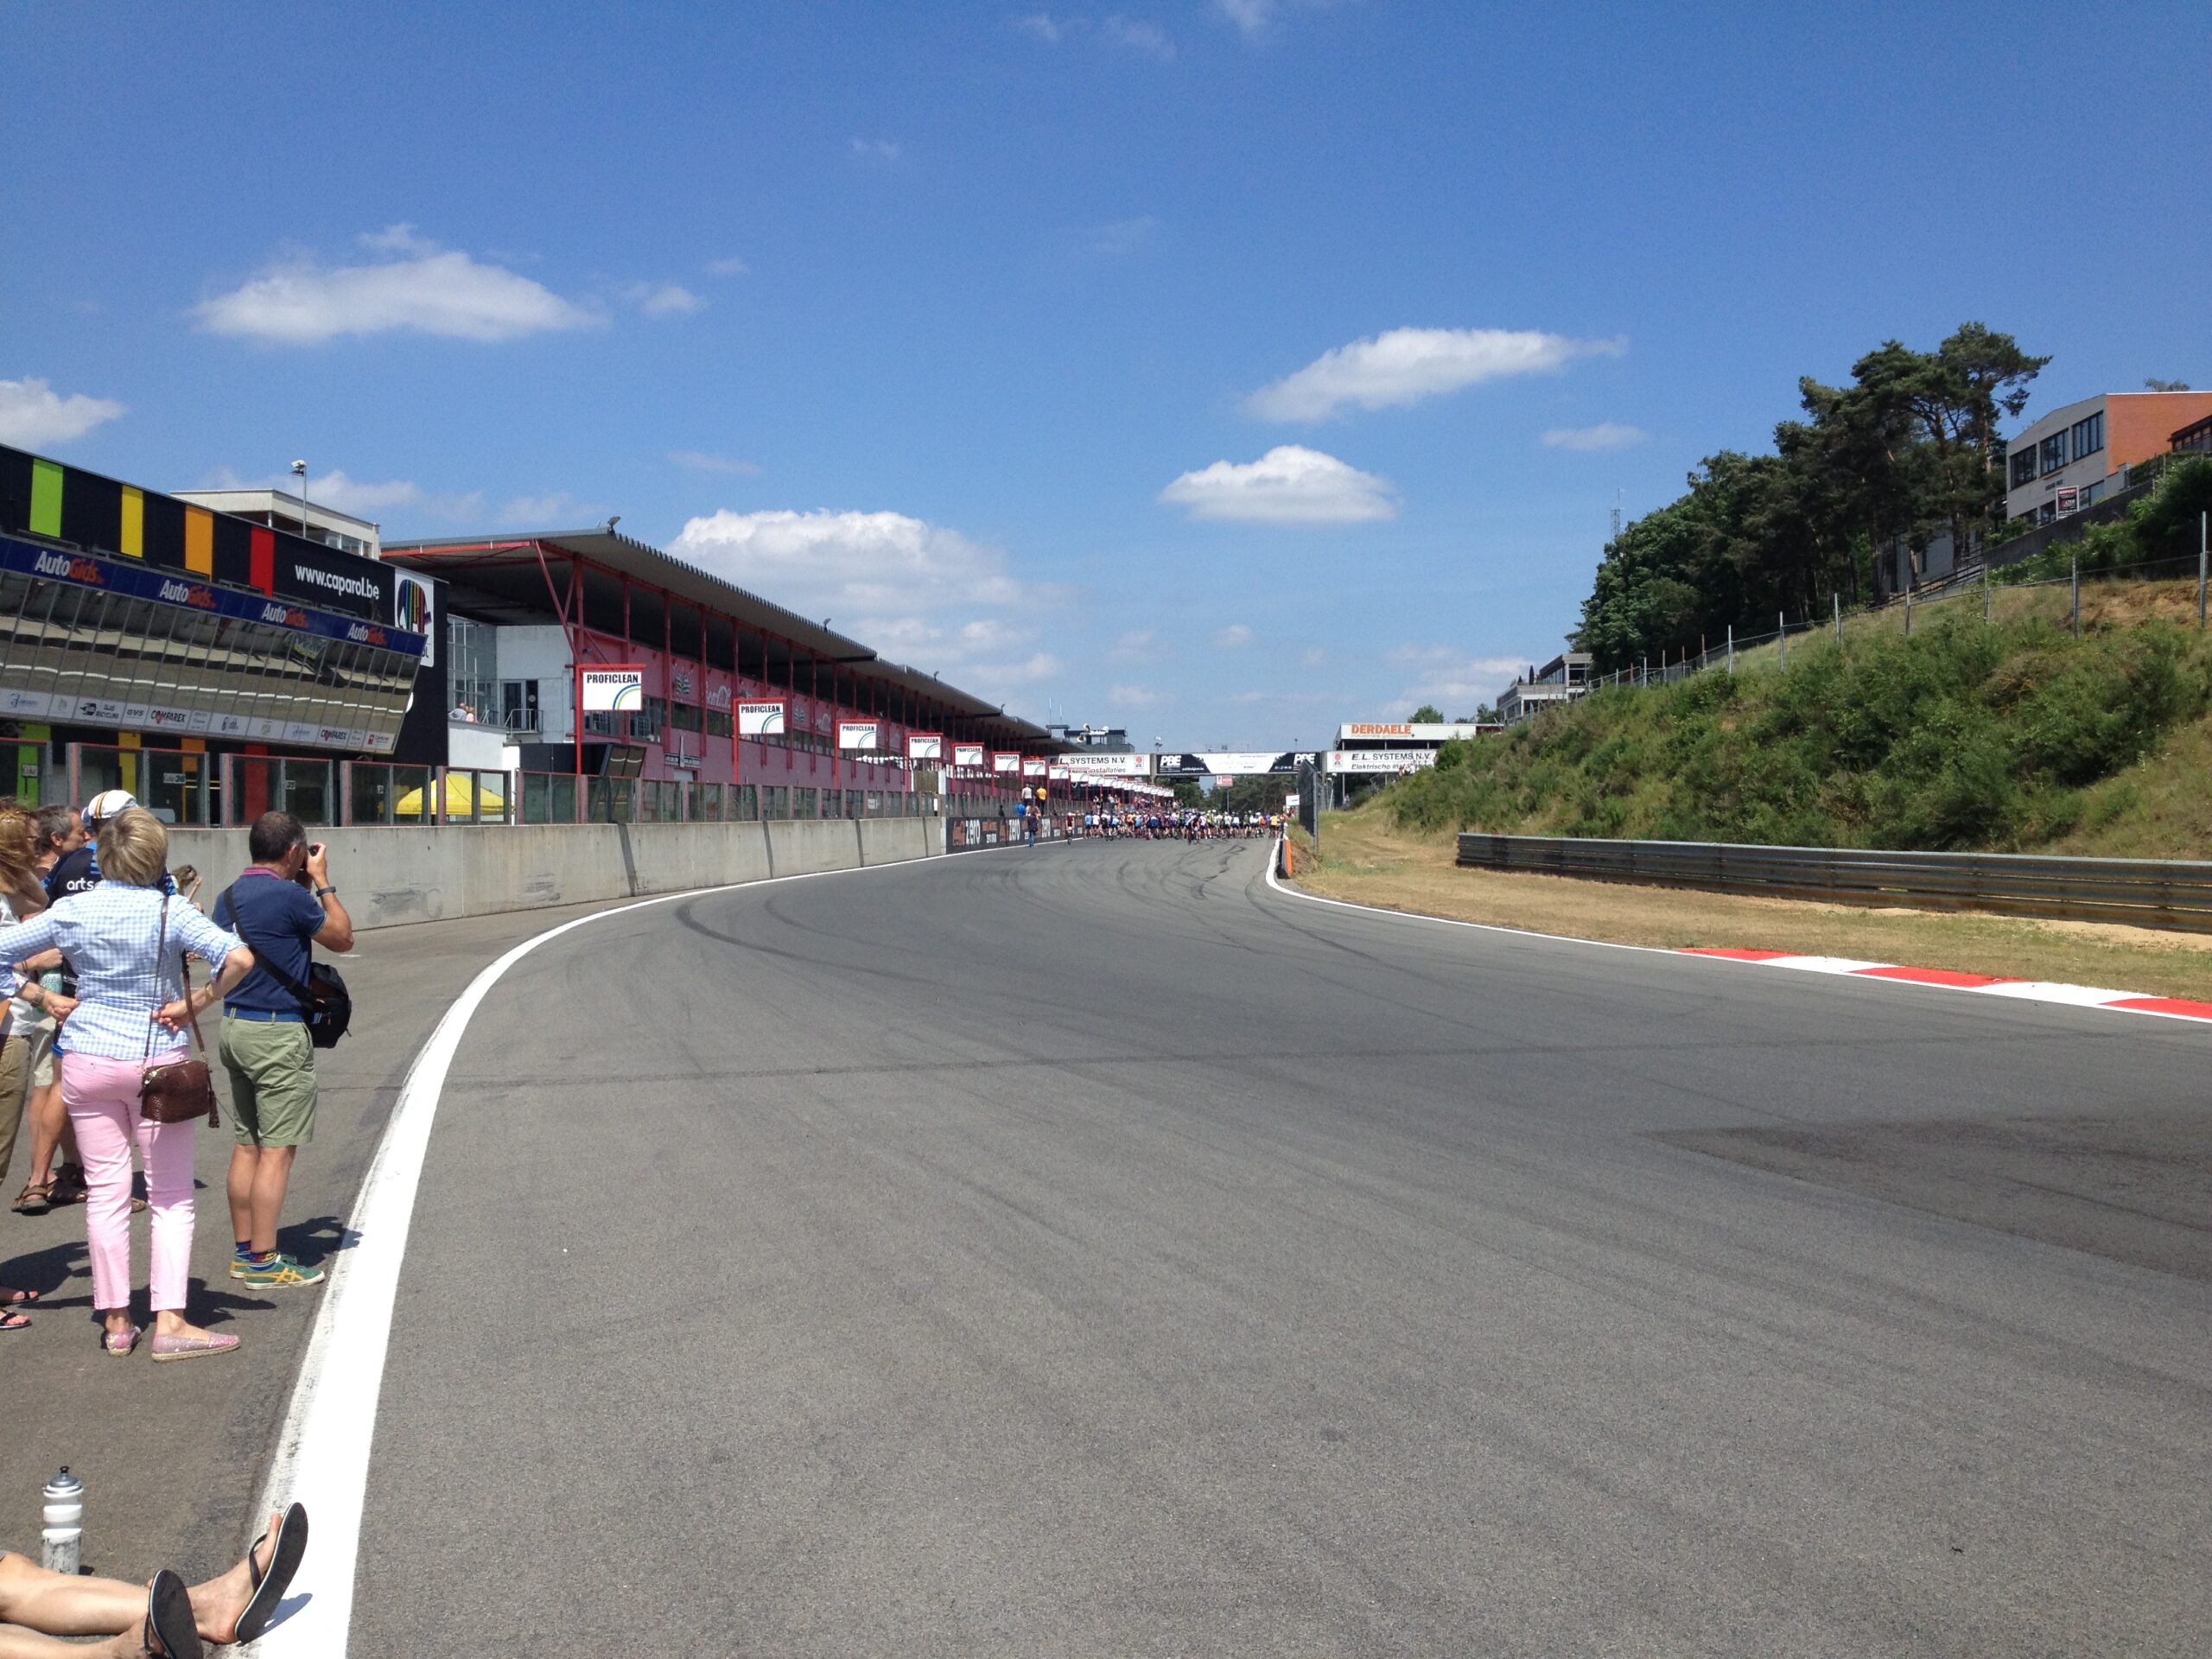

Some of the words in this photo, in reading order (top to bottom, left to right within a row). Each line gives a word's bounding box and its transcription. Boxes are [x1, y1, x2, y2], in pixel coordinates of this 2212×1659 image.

[295, 564, 380, 601] www.caparol.be
[587, 673, 639, 683] PROFICLEAN
[741, 704, 780, 714] PROFICLEAN
[1351, 724, 1411, 734] DERDAELE
[1160, 754, 1182, 766] PBE
[1351, 753, 1371, 761] E.L.
[965, 819, 981, 845] zero
